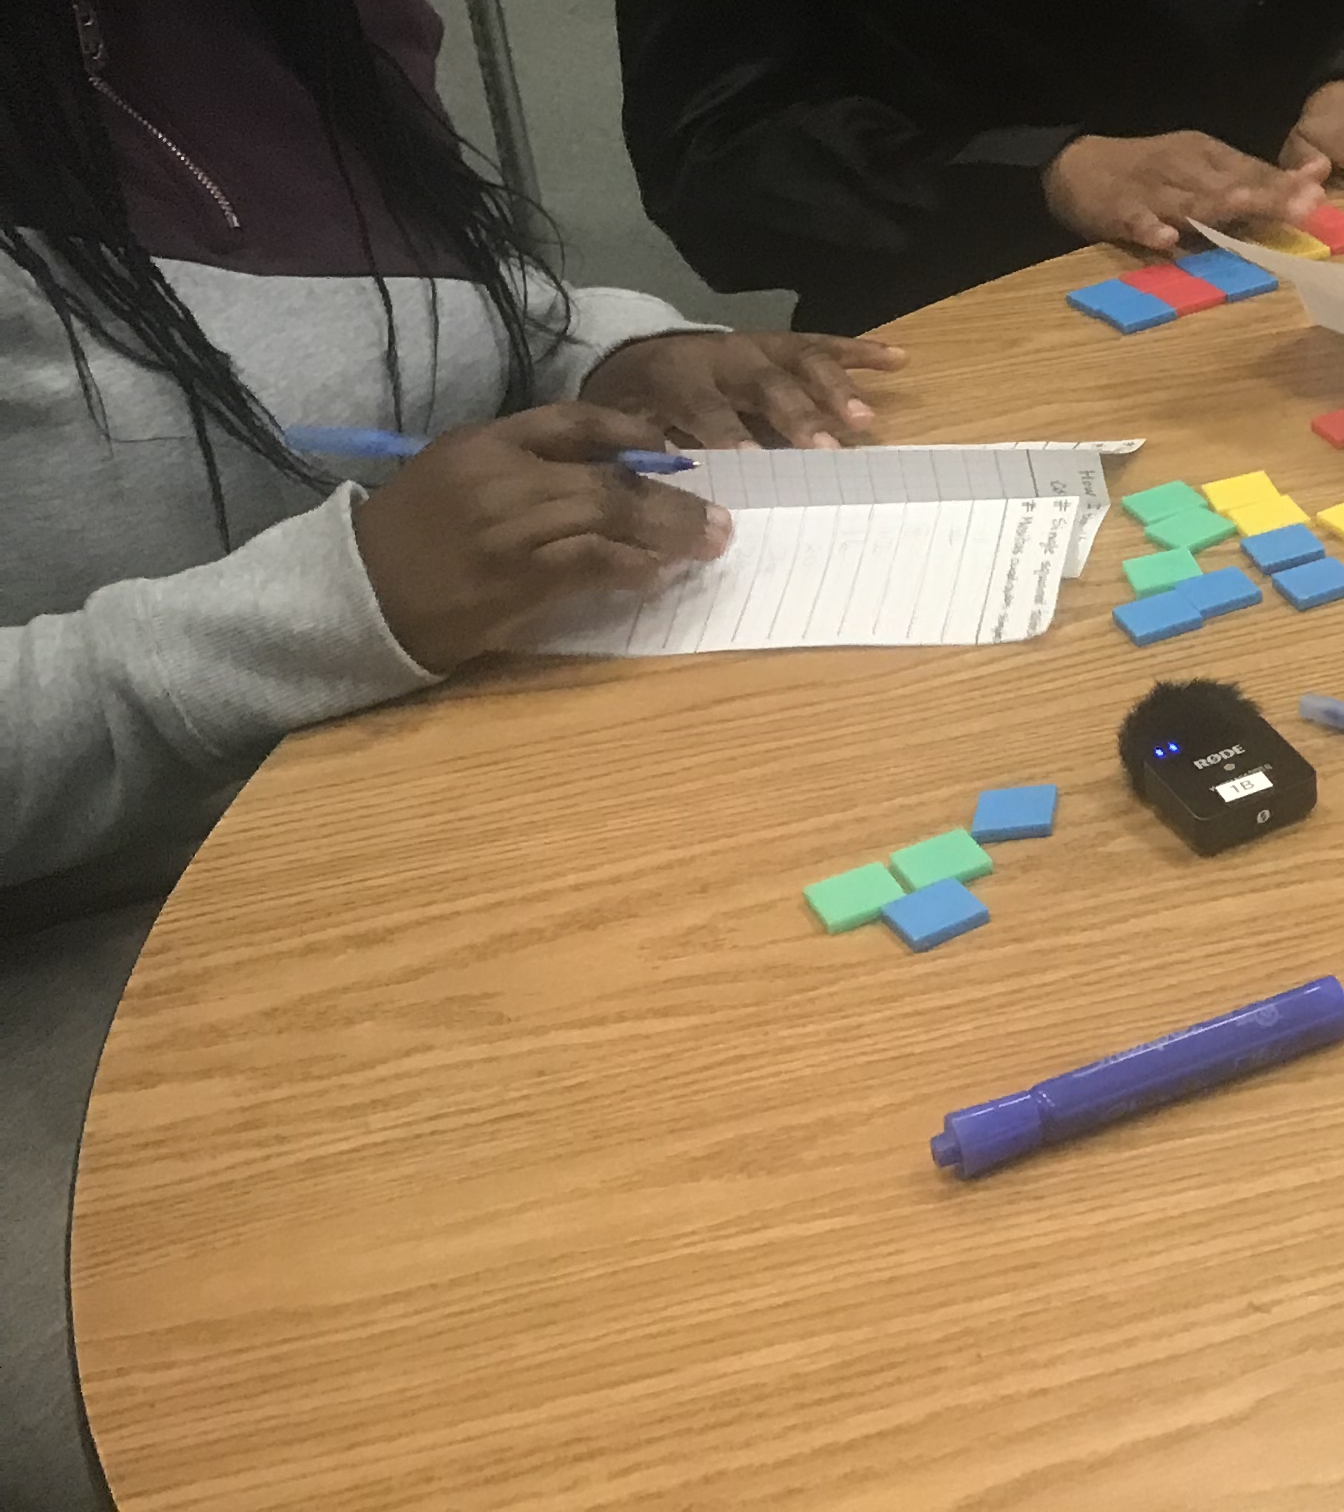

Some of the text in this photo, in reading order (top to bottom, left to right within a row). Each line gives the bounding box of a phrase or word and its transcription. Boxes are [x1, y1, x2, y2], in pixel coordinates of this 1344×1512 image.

[1078, 470, 1097, 497] How
[1054, 499, 1072, 512] #
[1230, 780, 1255, 793] 1B
